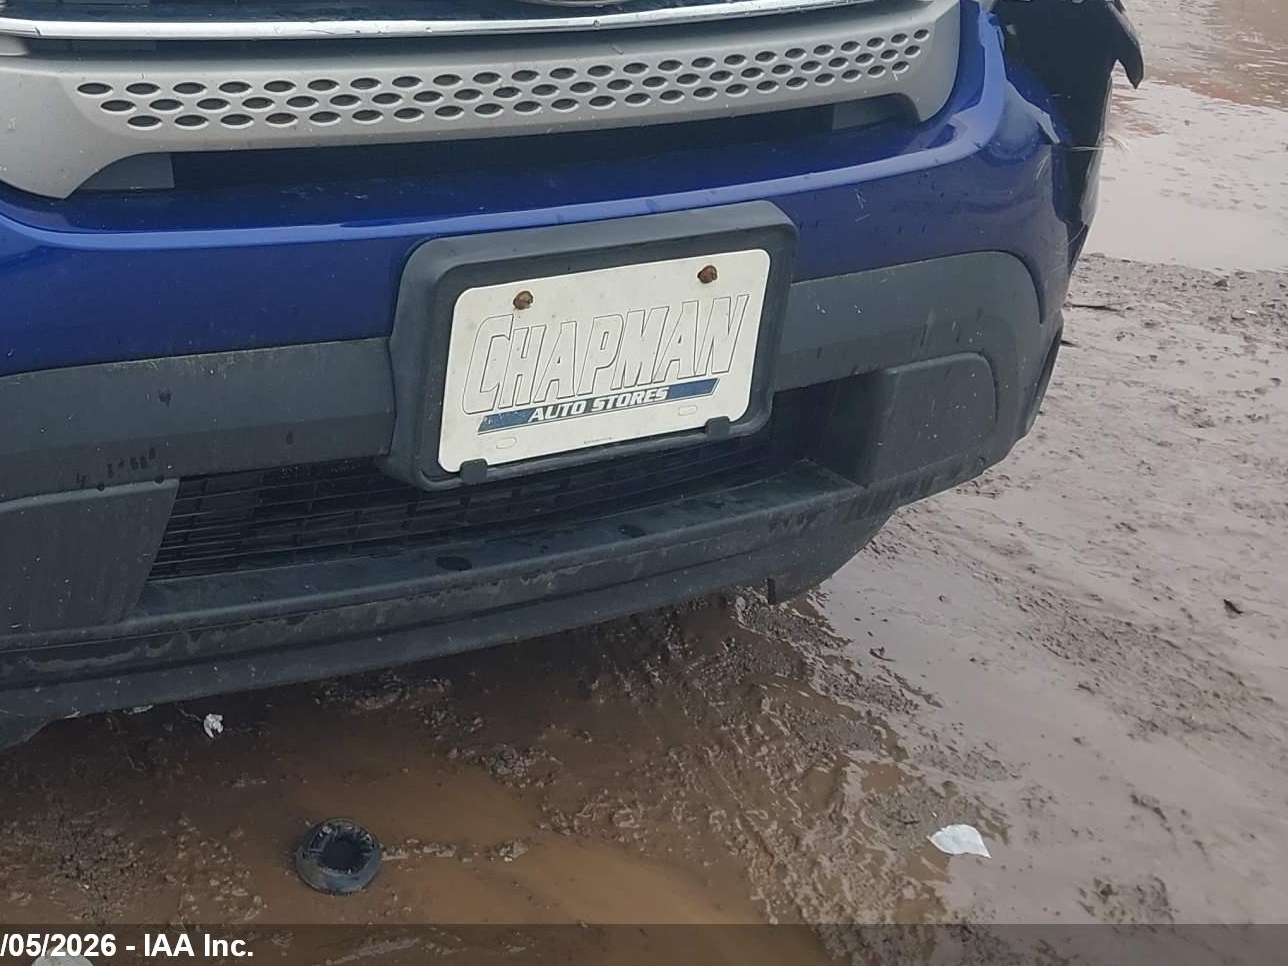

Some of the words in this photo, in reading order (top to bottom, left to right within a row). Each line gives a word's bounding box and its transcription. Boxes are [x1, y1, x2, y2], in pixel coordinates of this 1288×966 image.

[461, 294, 750, 415] CHAPMAN
[527, 401, 587, 423] AUTO
[591, 387, 669, 413] STORES
